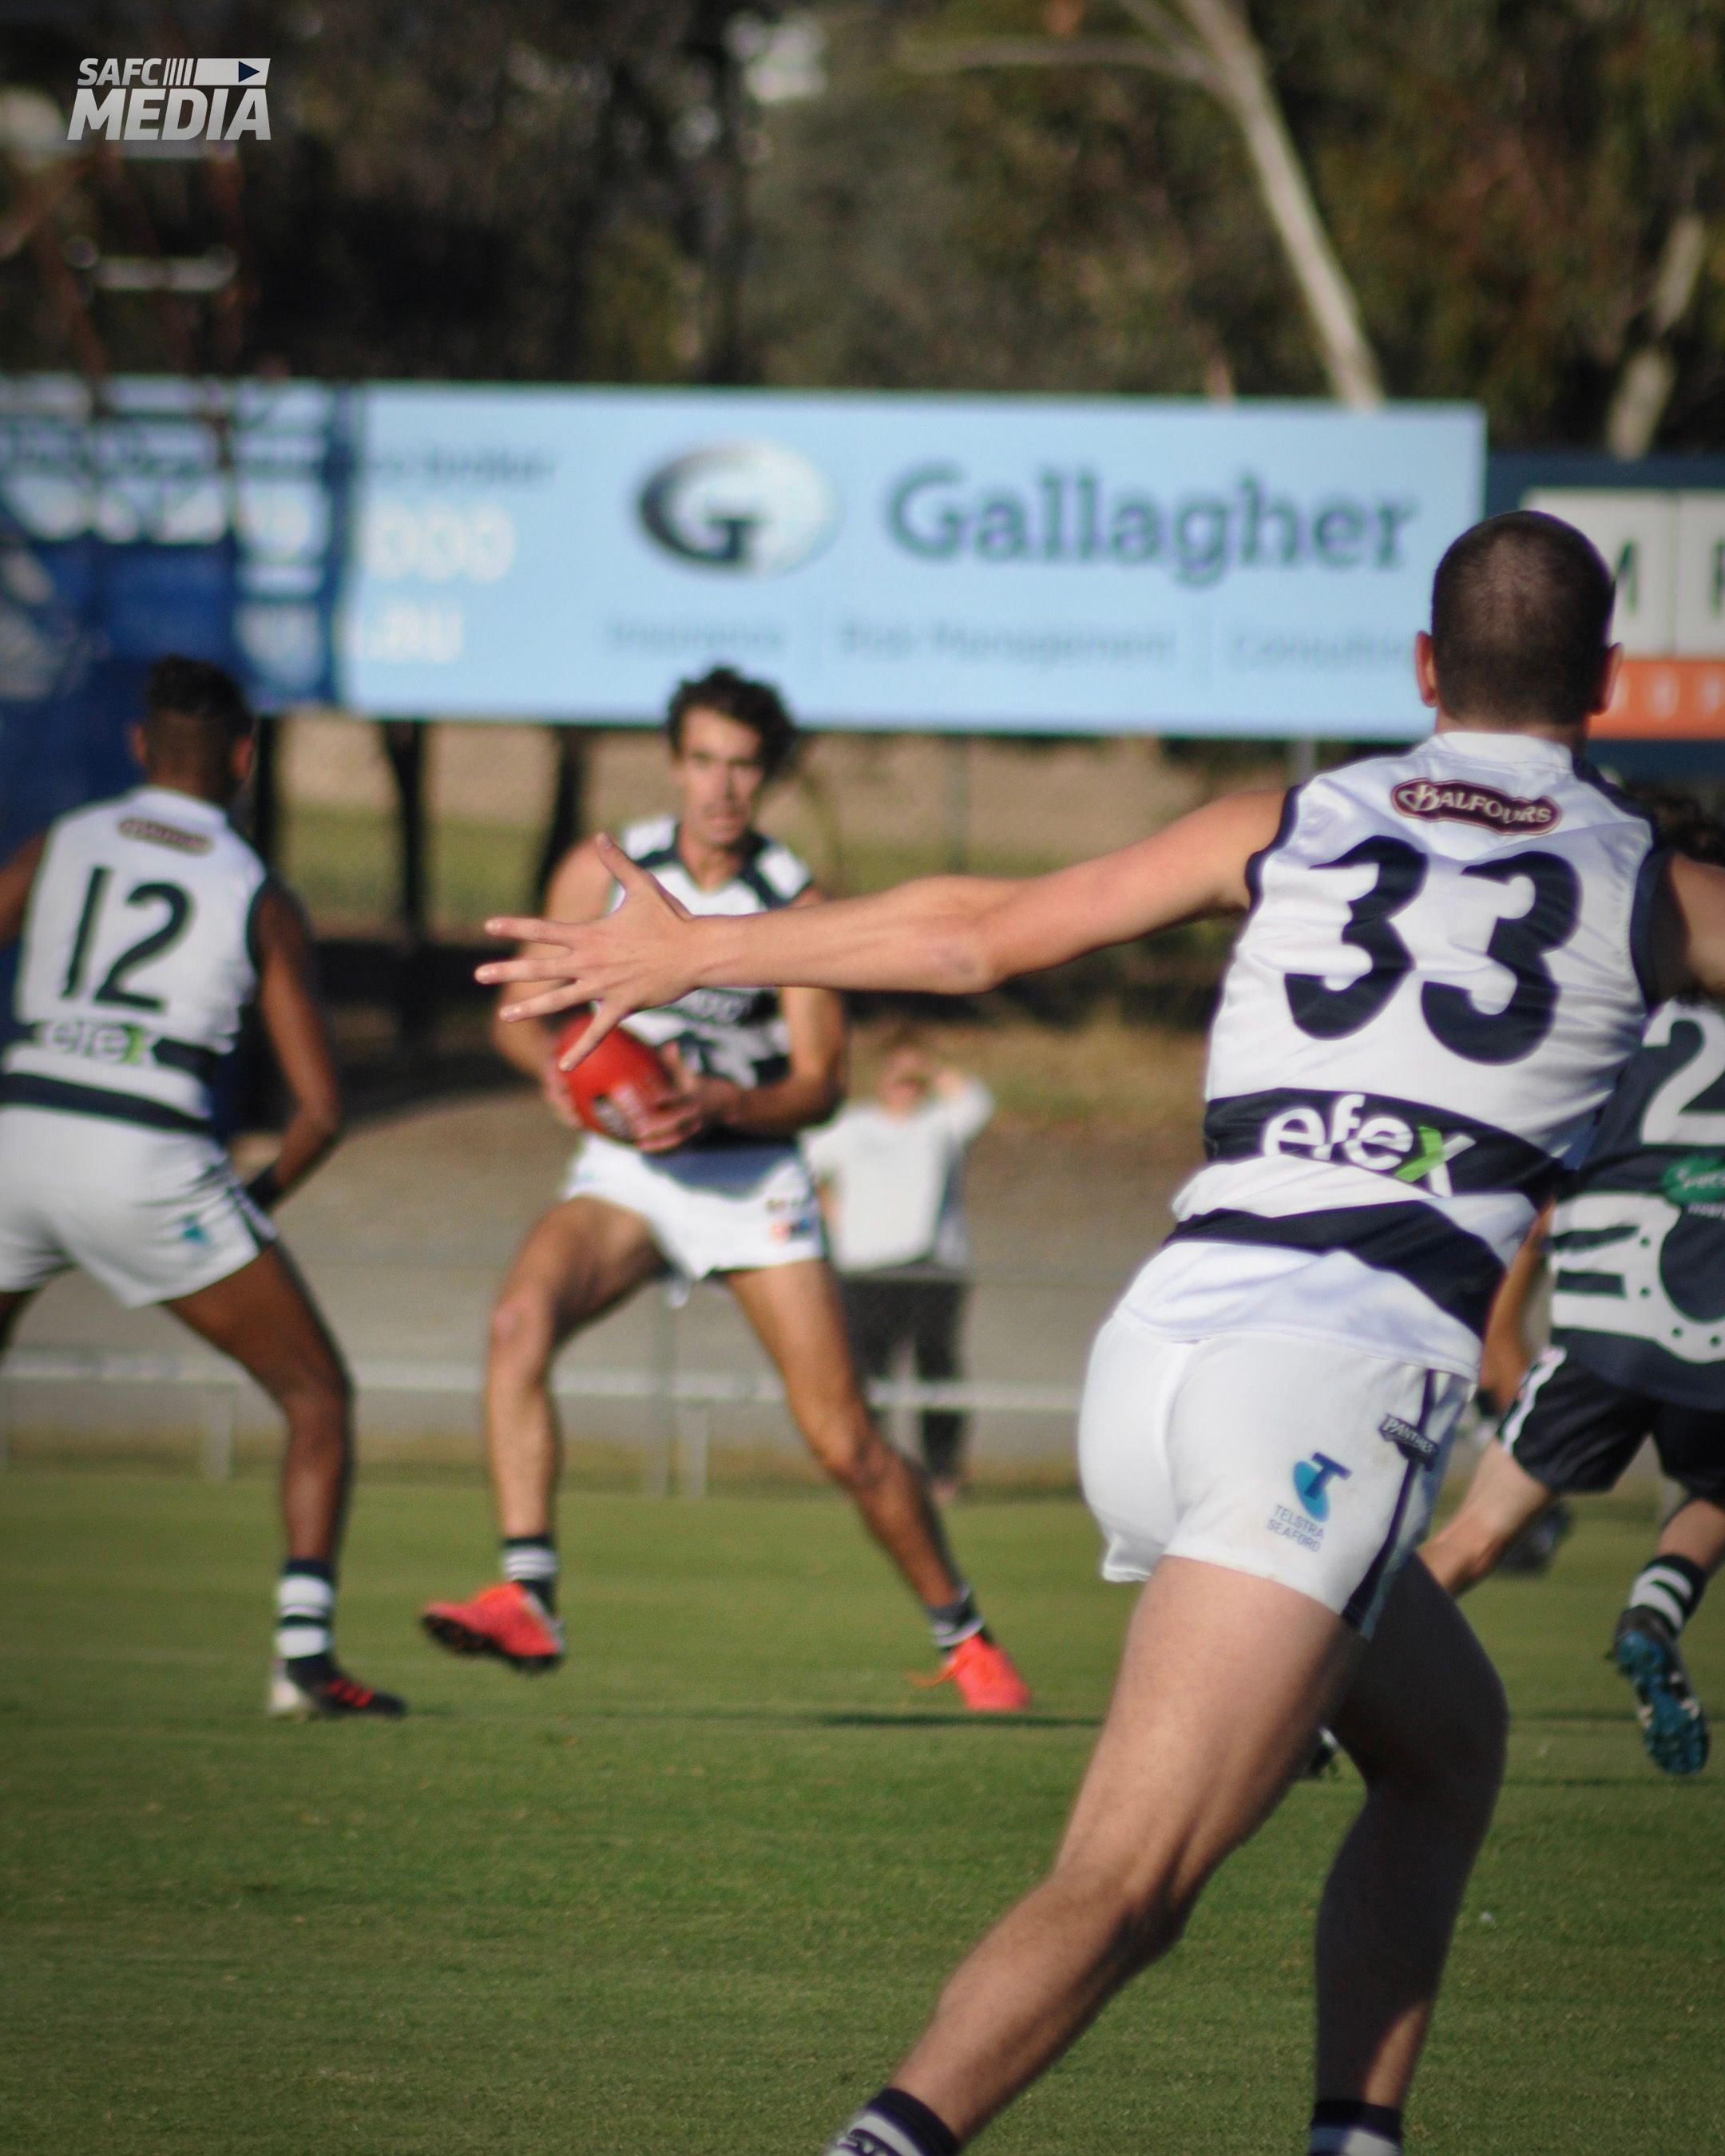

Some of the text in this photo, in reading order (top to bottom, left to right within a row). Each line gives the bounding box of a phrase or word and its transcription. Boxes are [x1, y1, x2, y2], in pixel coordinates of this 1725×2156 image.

[886, 462, 1417, 589] Gallagher
[1227, 626, 1418, 671] Consultin
[1398, 783, 1552, 824] BALFOURS
[61, 865, 197, 1016] 12
[1283, 835, 1583, 1066] 33
[1263, 1094, 1476, 1198] efex
[1267, 1519, 1322, 1552] SEAFORD
[1274, 1504, 1325, 1540] TELSTRA
